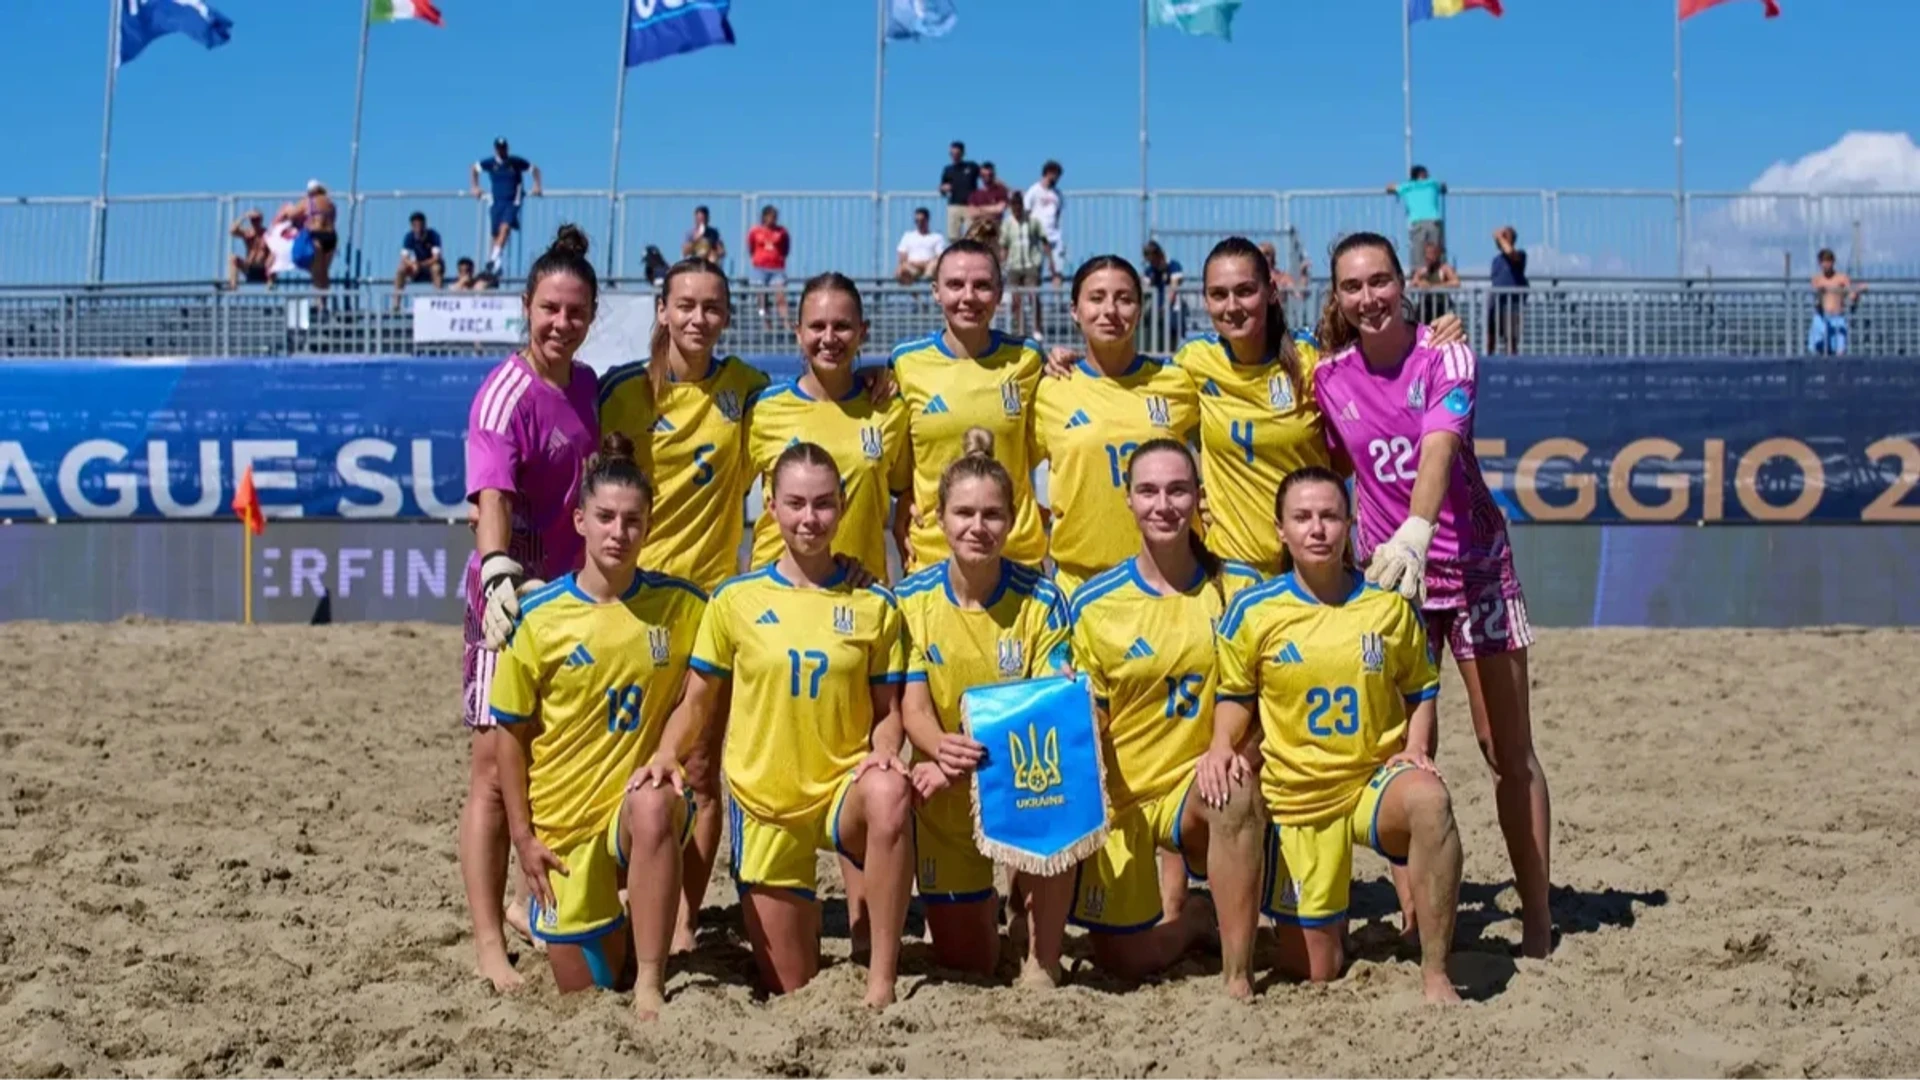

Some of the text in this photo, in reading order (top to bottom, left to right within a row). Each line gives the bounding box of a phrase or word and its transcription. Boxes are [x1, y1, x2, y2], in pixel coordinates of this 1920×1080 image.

[692, 443, 716, 486] 5
[1231, 420, 1254, 463] 4
[1369, 436, 1418, 482] 22
[1861, 436, 1920, 521] 2
[788, 648, 829, 699] 17
[1165, 673, 1203, 719] 15
[1306, 686, 1360, 736] 23
[1016, 795, 1064, 809] UKRAINE
